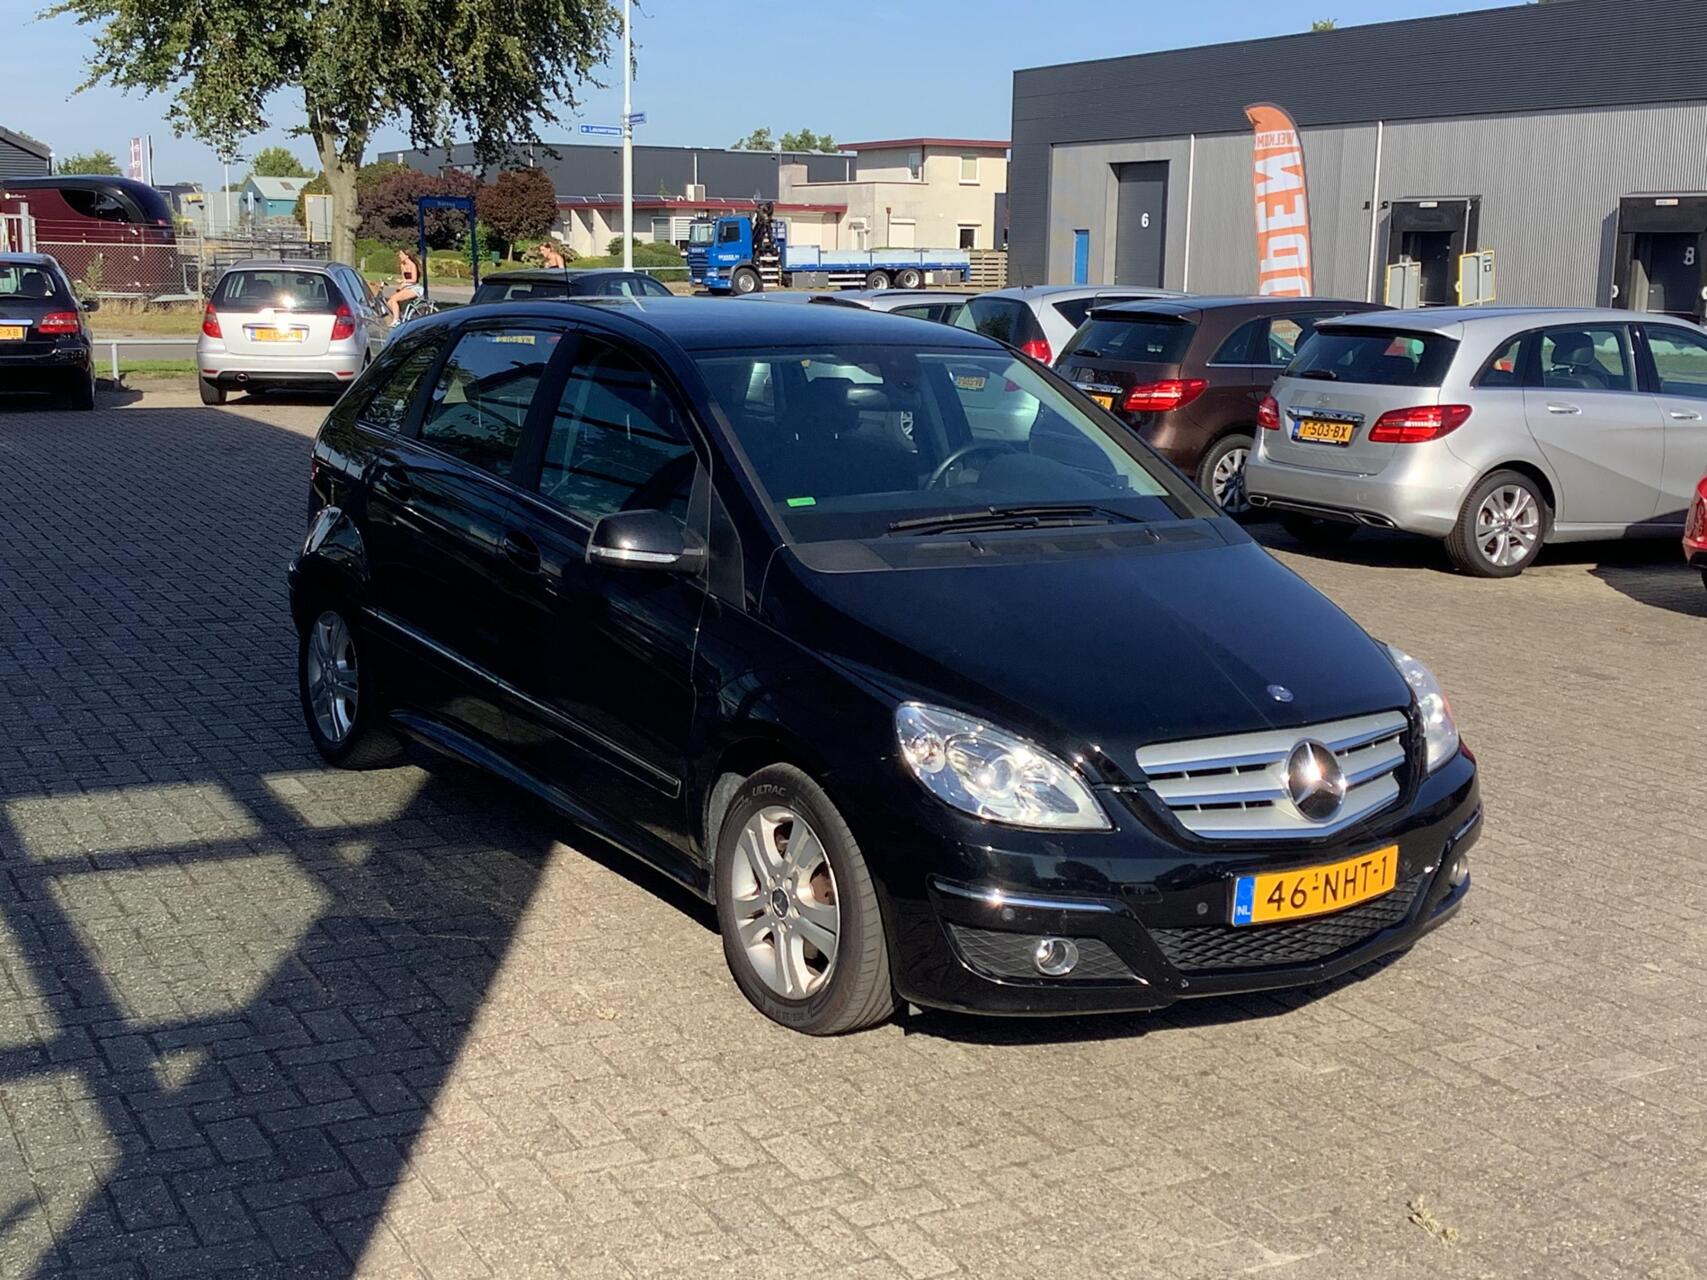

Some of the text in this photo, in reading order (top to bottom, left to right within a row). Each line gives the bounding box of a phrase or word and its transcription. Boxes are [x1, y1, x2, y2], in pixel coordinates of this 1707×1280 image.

[1141, 212, 1150, 228] 6
[1683, 246, 1695, 265] 8
[1302, 421, 1349, 440] T-503-BX
[752, 783, 787, 797] ULTRAC
[1266, 855, 1388, 912] 46-NHT-1
[1236, 905, 1251, 916] NL
